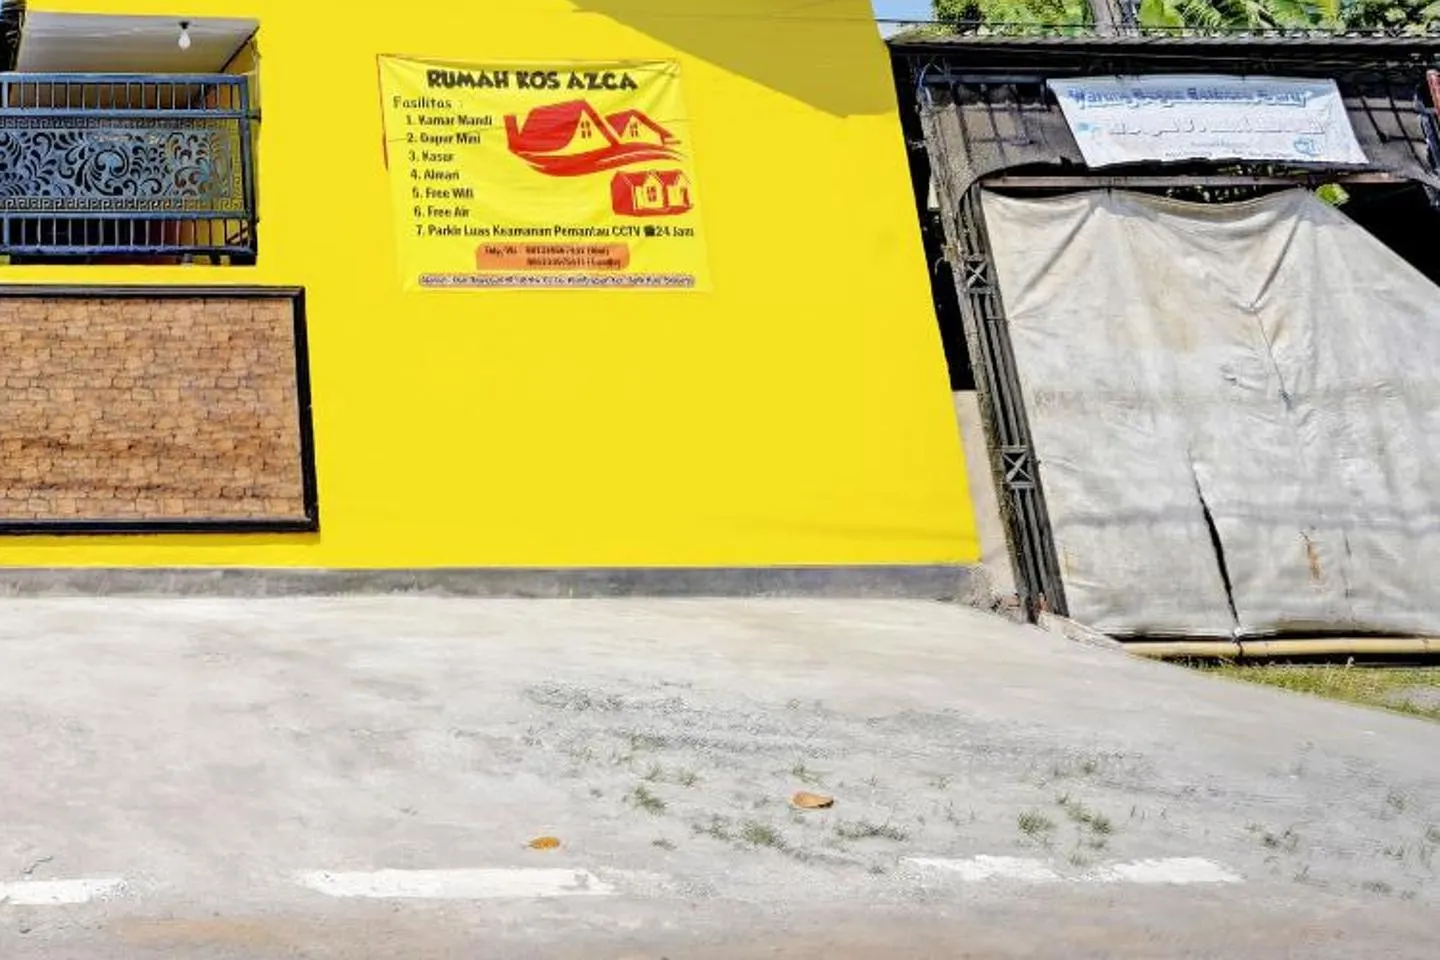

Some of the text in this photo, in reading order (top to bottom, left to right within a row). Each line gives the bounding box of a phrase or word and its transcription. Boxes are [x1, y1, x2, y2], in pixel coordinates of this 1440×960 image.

[427, 69, 638, 90] RUMAH KOS AZCA
[393, 96, 452, 109] Fasilitas
[418, 114, 455, 125] Kamar
[458, 114, 492, 125] Mandi
[422, 150, 454, 161] Kasur
[426, 187, 450, 198] Free
[428, 205, 451, 217] Free
[454, 206, 470, 217] Air
[428, 224, 461, 236] Parkir
[464, 224, 490, 237] Luas
[493, 225, 552, 237] Keamanan
[554, 225, 609, 237] Pemantau
[612, 226, 640, 237] CCTV
